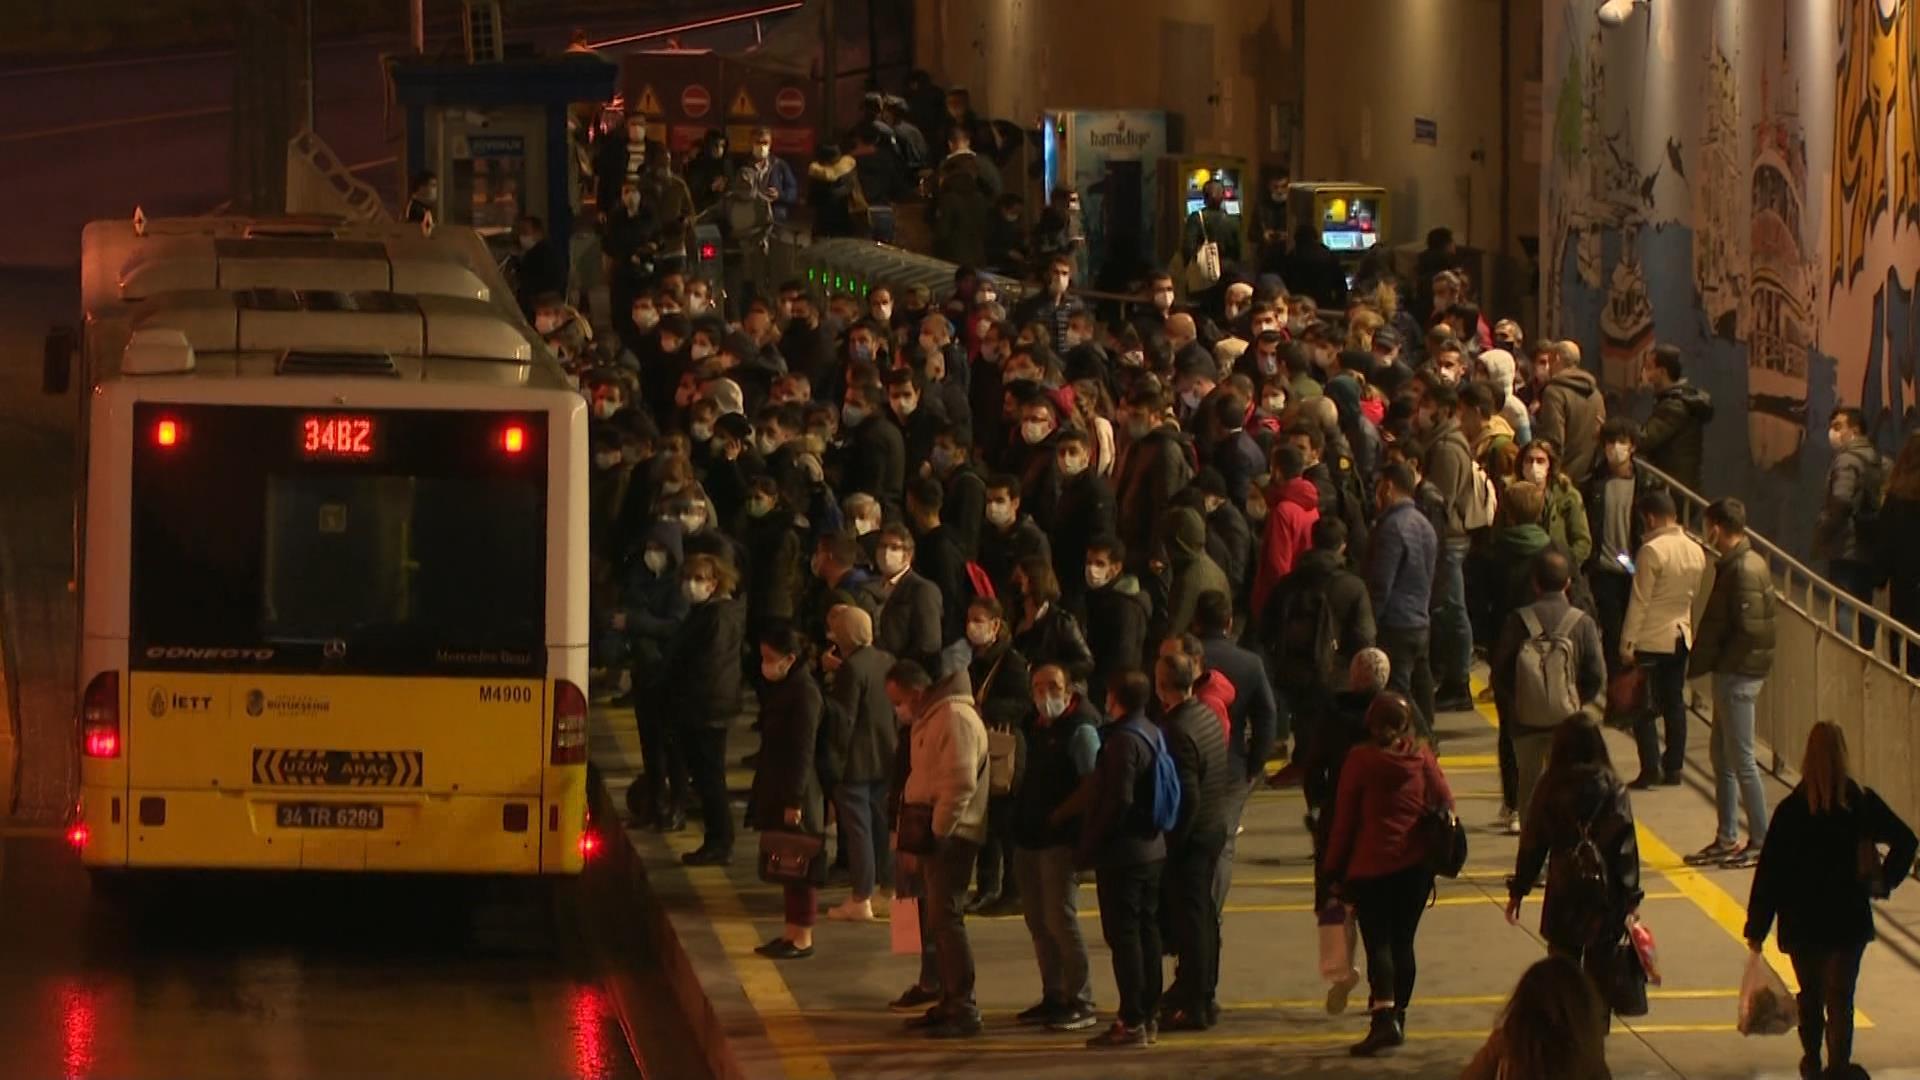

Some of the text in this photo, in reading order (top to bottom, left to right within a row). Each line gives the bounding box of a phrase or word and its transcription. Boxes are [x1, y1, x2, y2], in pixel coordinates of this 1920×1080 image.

[304, 418, 371, 453] 34B2
[479, 685, 532, 703] M4900
[283, 760, 329, 775] UZUN
[281, 806, 379, 828] 34 TR 6289
